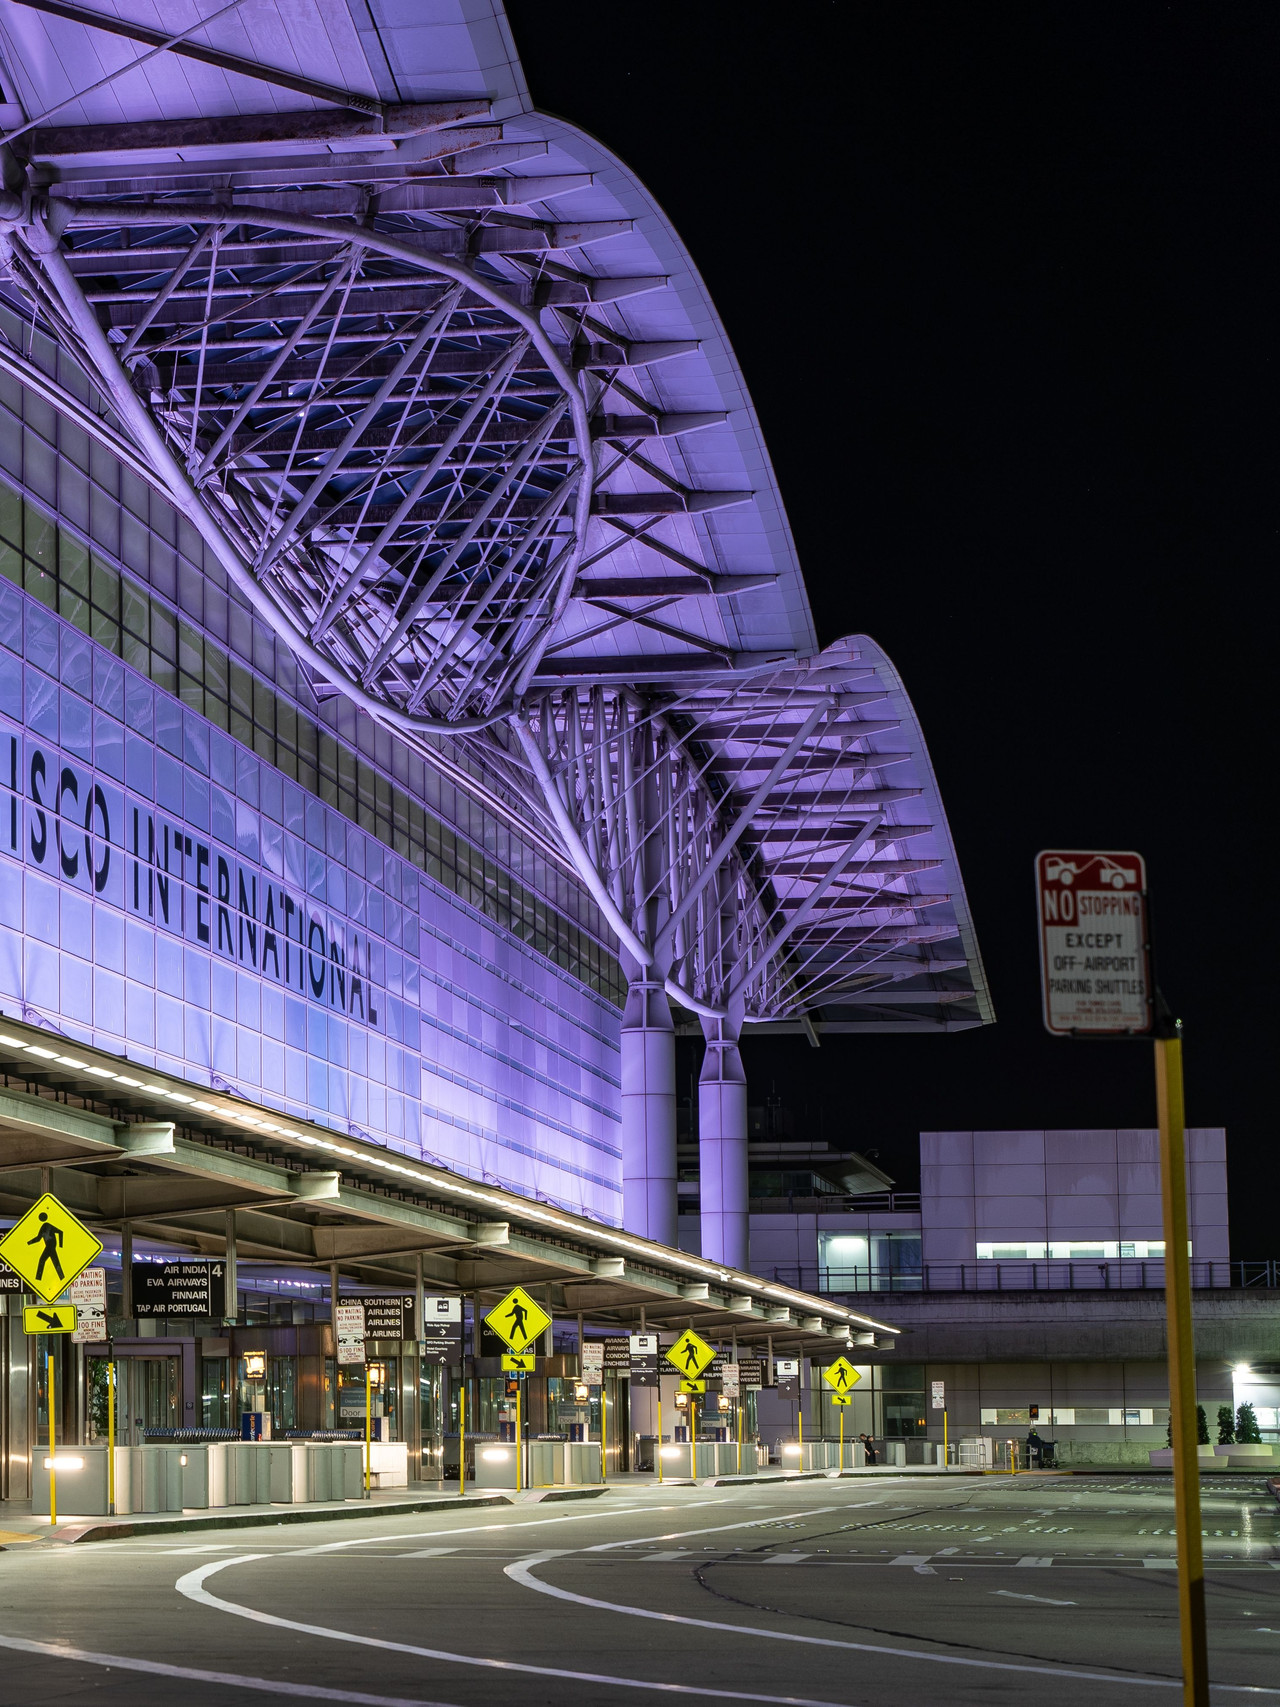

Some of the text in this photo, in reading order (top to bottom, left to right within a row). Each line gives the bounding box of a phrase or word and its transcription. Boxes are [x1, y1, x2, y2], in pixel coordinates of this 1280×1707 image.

[1043, 889, 1140, 922] NO STOPPING
[133, 807, 377, 1026] INTERNATIONAL
[1065, 933, 1123, 948] EXCEPT
[1053, 955, 1136, 971] OFF-AIRPORT
[1050, 978, 1145, 995] PARKING SHUTTLES
[80, 1271, 102, 1279] WAITING
[163, 1264, 223, 1278] AIR INDIA 4
[147, 1278, 207, 1287] EVA AIRWAYS
[172, 1291, 207, 1299] FINNAIR
[136, 1304, 207, 1313] TAP AIR PORTUGAL
[404, 1297, 413, 1309] 3
[367, 1308, 401, 1316] AIRLINES
[342, 1409, 360, 1417] Door
